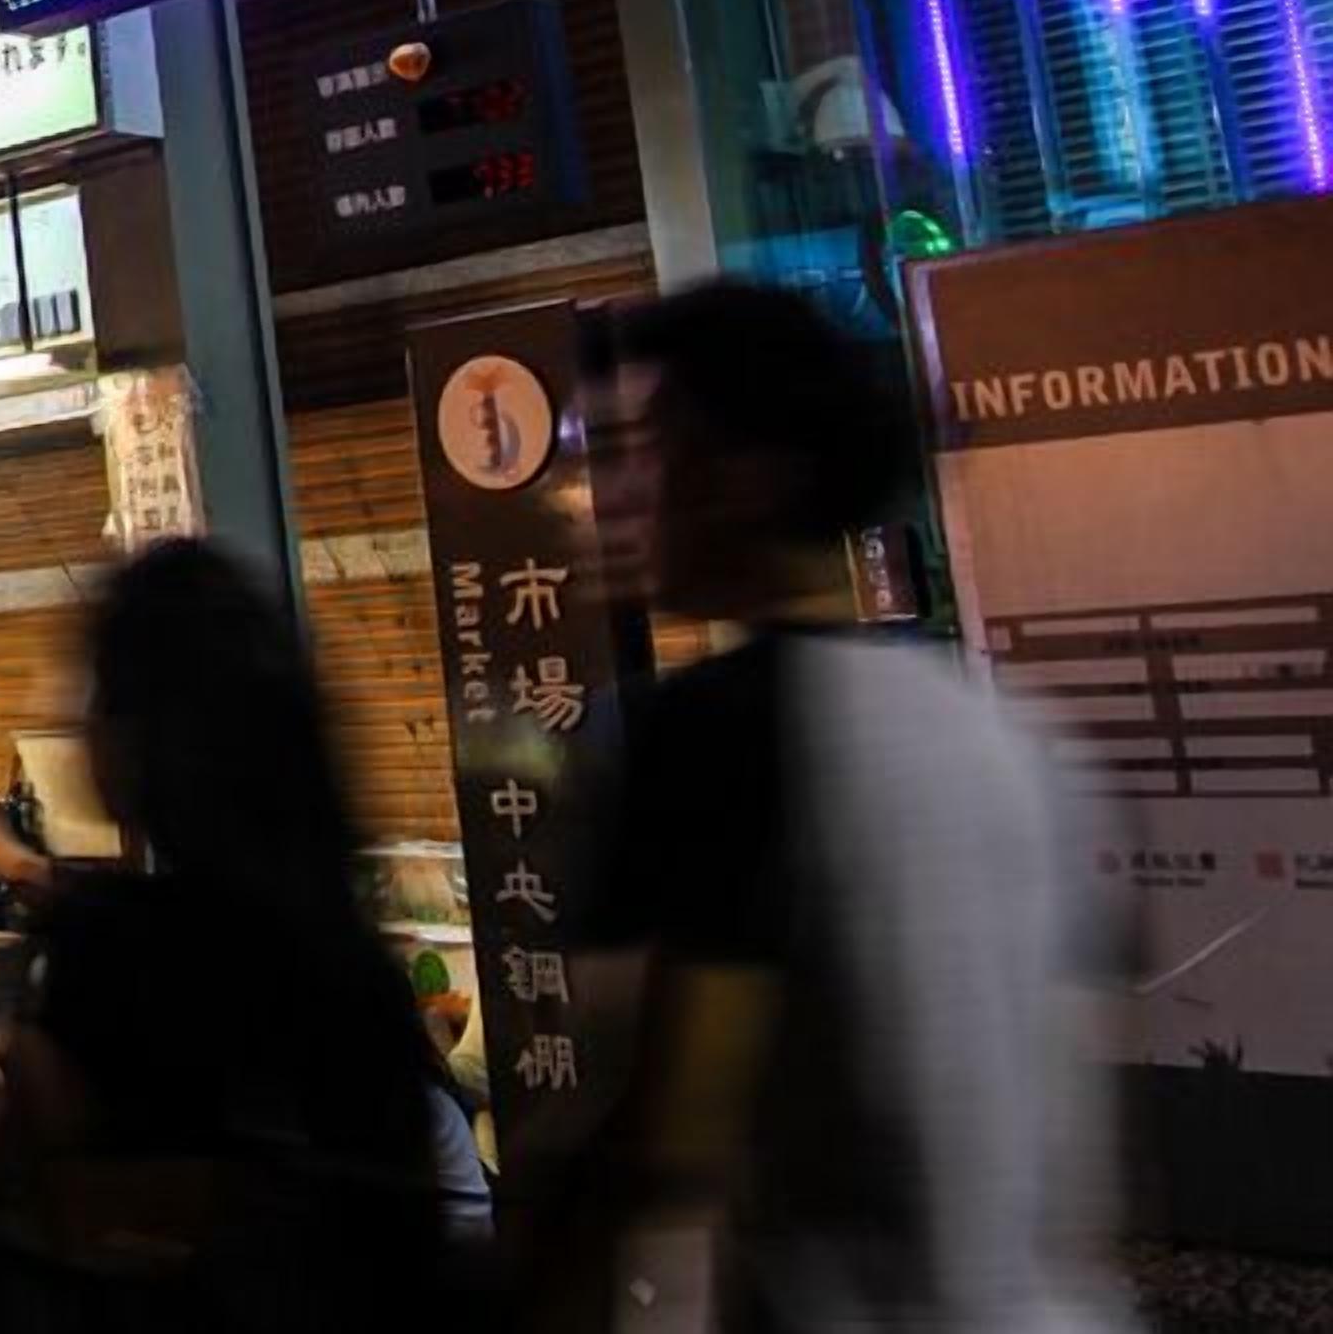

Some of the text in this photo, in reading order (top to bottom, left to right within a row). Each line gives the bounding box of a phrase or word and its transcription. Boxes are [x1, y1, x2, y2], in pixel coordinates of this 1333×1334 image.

[949, 335, 1333, 422] INFORMATION
[449, 561, 497, 722] Market
[498, 557, 585, 730] 市場
